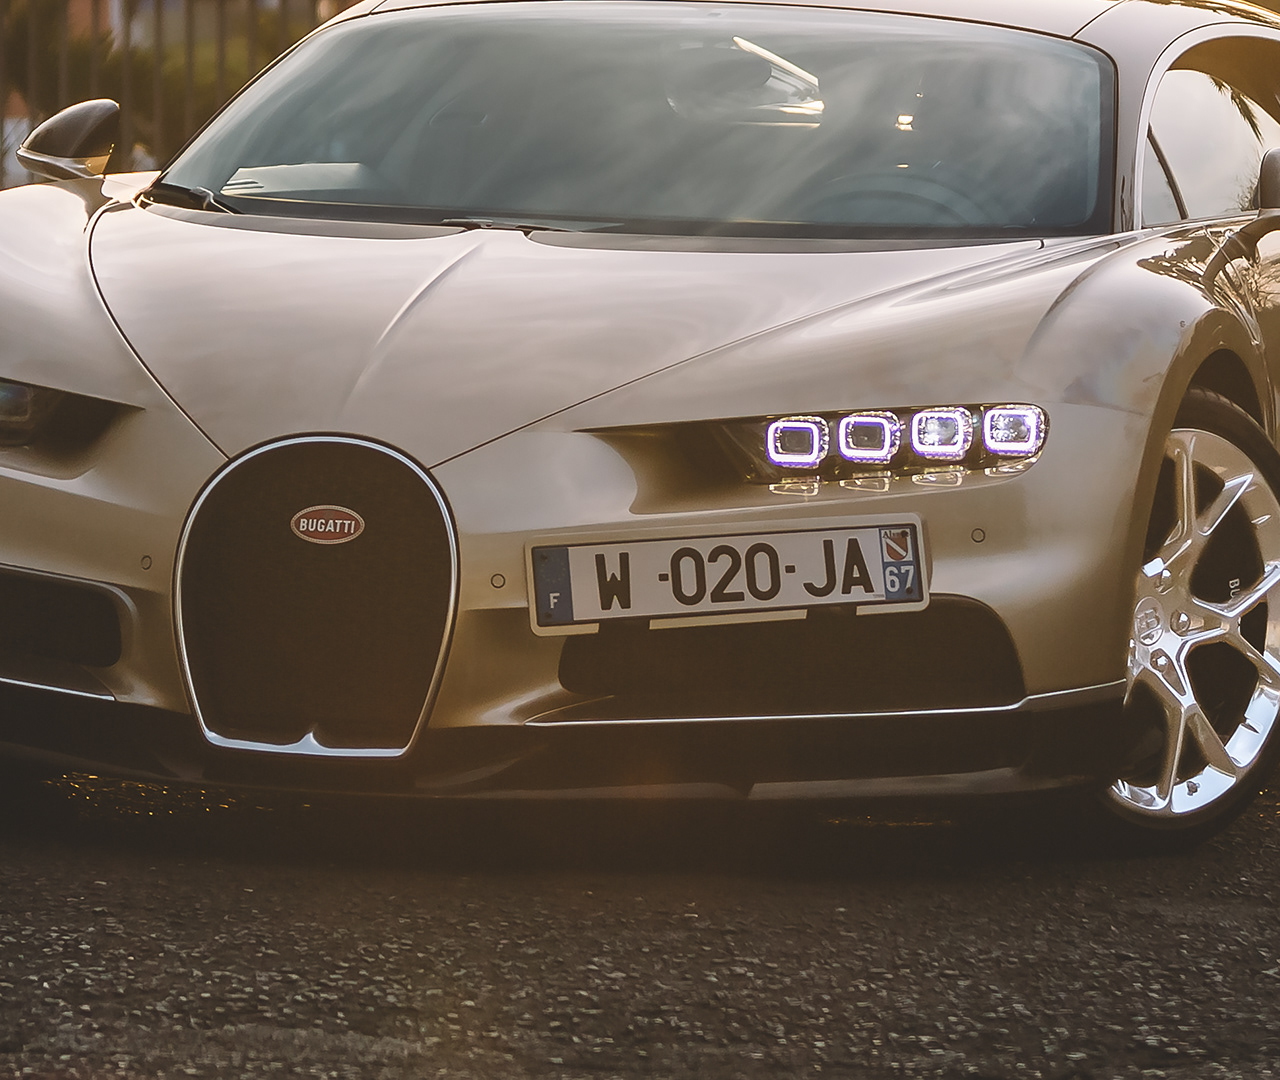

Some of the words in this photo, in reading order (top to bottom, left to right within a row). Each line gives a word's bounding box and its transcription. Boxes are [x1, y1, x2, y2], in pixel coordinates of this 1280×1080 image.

[299, 519, 356, 534] BUGATTI
[885, 566, 914, 593] 67
[549, 592, 561, 609] F
